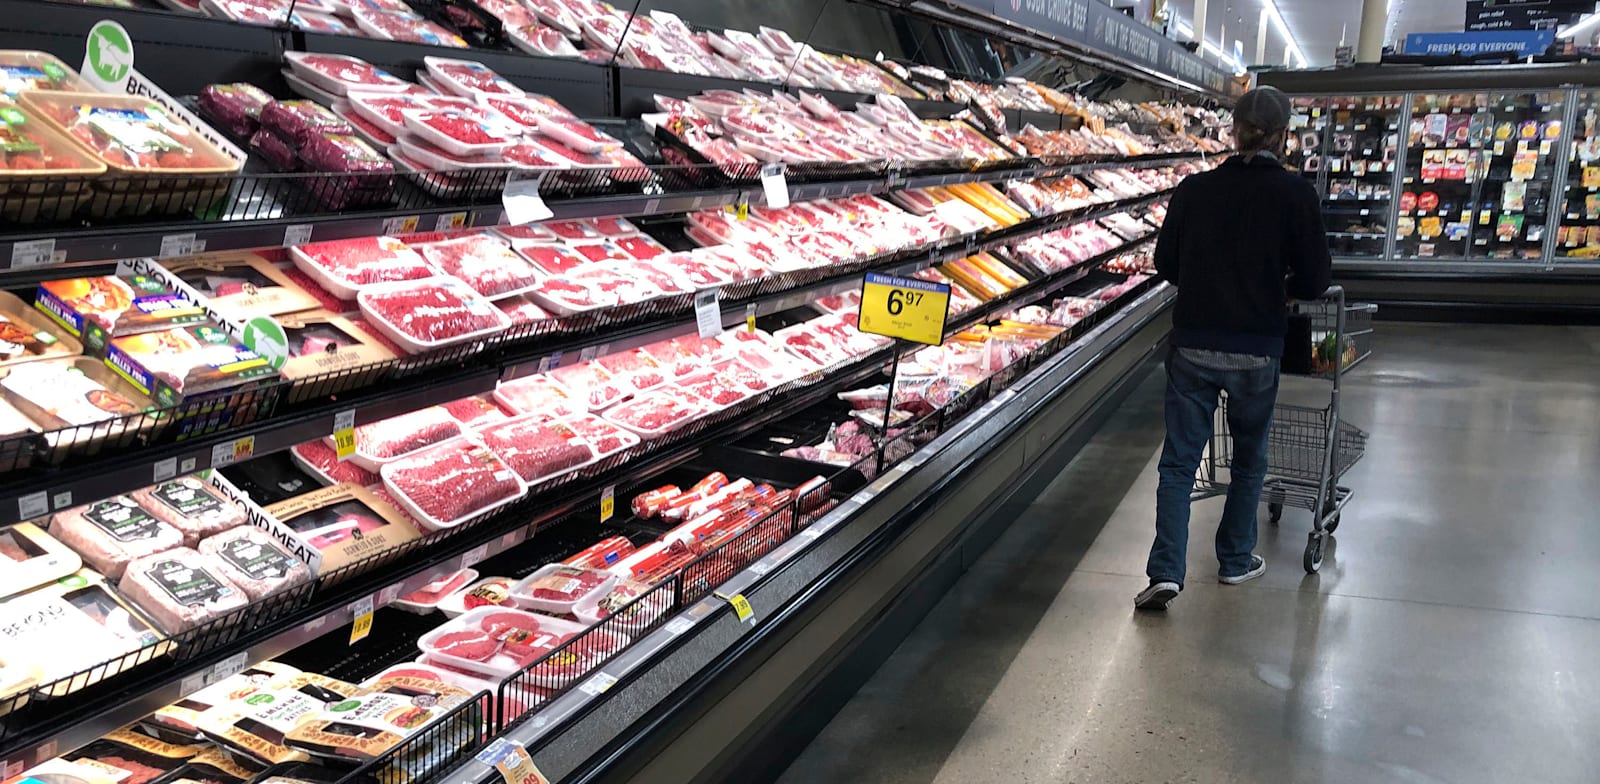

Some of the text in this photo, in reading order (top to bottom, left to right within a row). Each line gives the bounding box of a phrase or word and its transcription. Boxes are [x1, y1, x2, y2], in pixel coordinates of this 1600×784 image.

[1072, 2, 1088, 32] BEEF
[1427, 42, 1526, 53] FRESH FOR EVERYONE
[873, 274, 938, 291] FRESH FOR EVERYONE
[193, 301, 238, 336] EAT
[212, 477, 270, 532] BEYOND
[271, 526, 315, 565] MEAT
